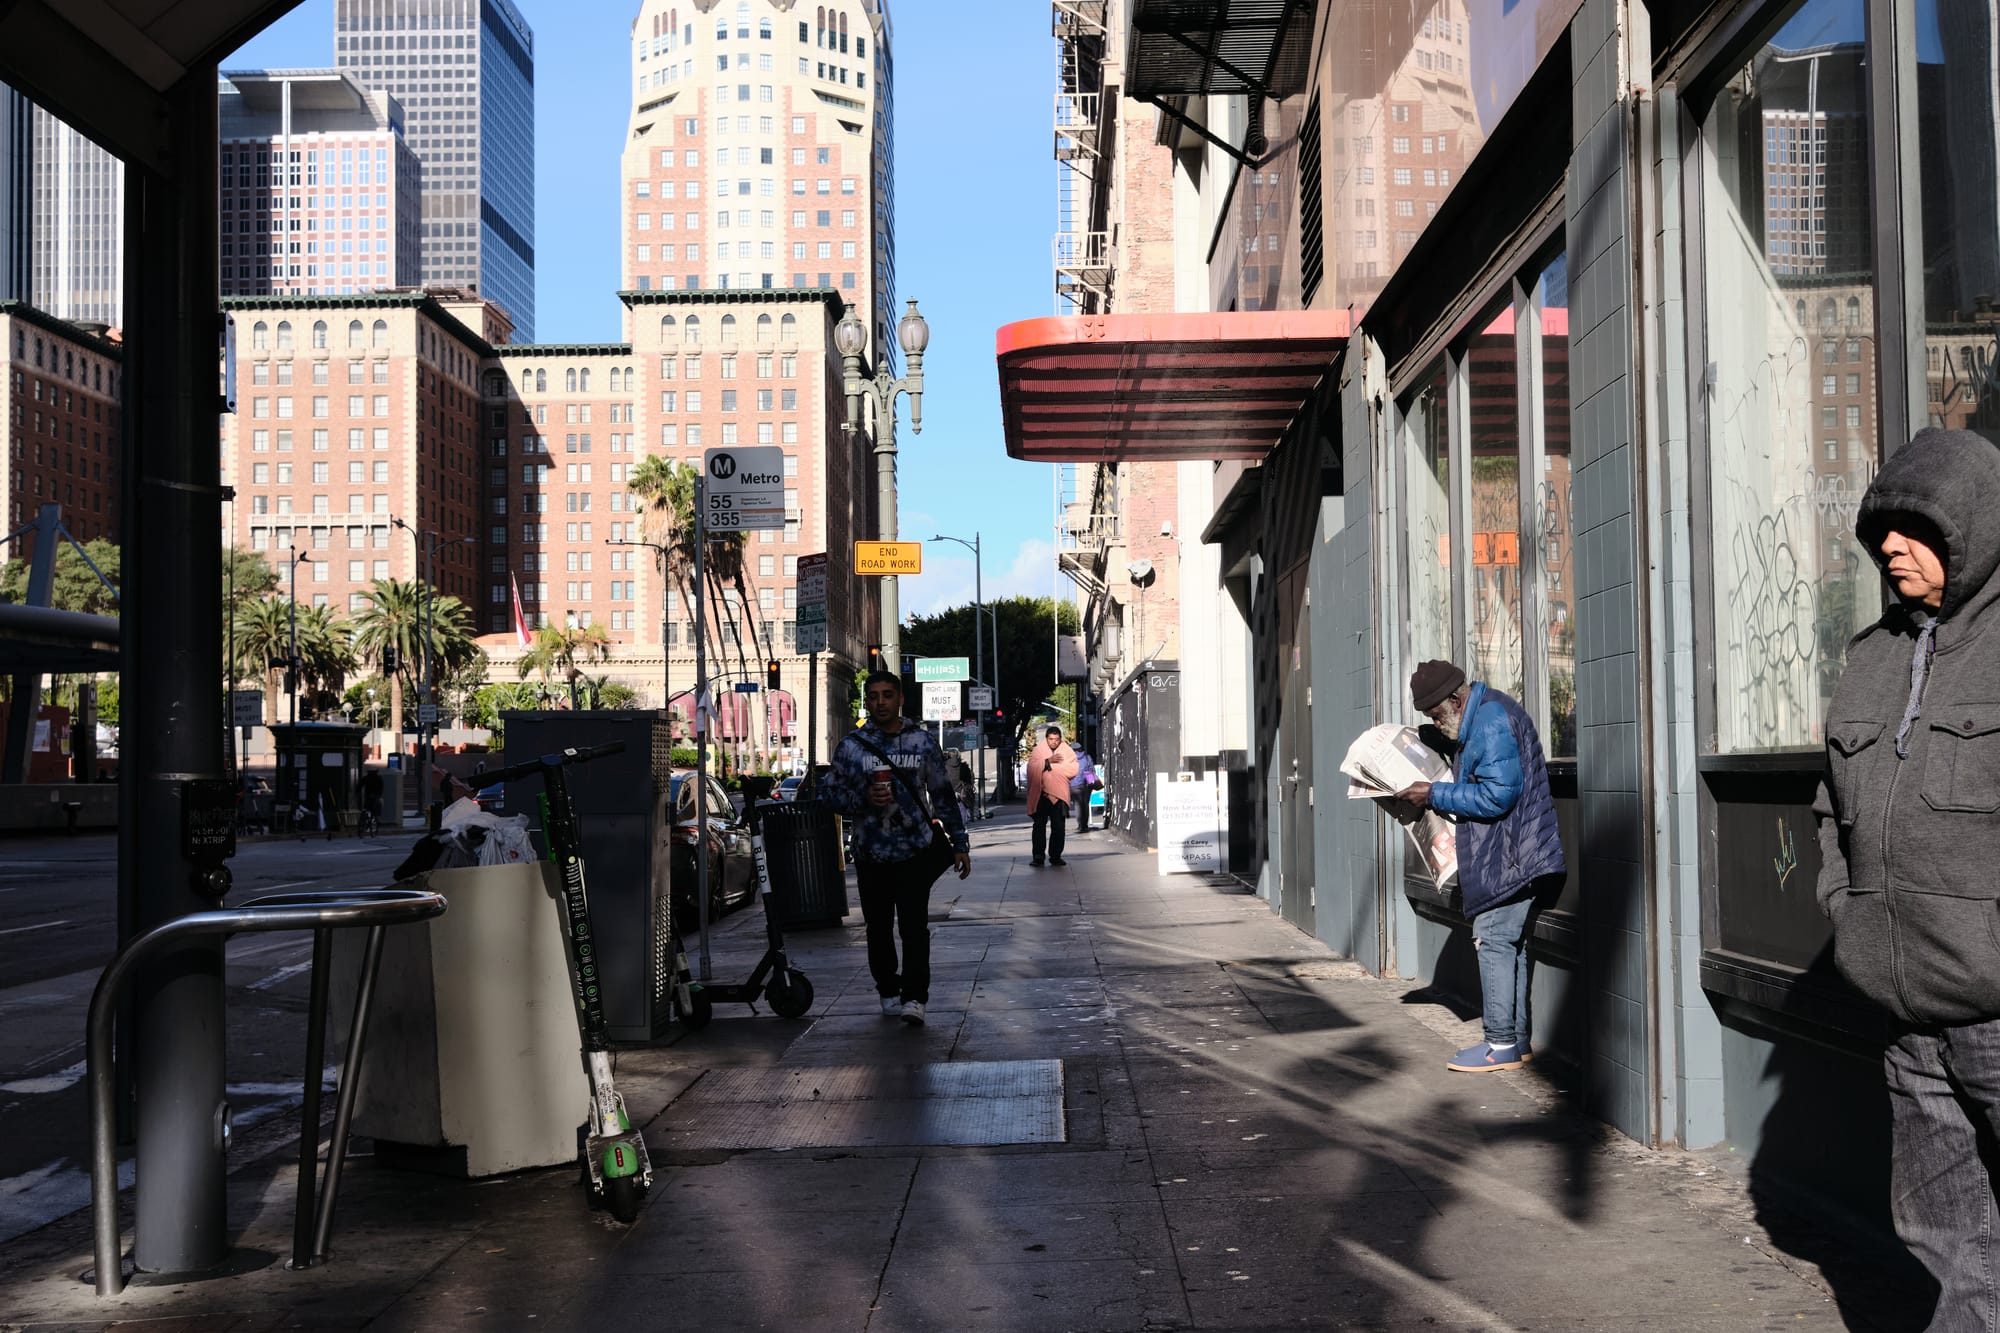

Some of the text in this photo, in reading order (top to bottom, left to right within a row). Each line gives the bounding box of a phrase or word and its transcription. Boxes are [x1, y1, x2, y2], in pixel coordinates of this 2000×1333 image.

[714, 458, 732, 475] M
[741, 473, 781, 485] Metro
[710, 495, 732, 509] 55
[711, 512, 740, 526] 355
[879, 547, 898, 557] END
[861, 559, 916, 569] ROAD WORK
[924, 664, 961, 675] Hill St
[931, 696, 951, 705] MUST
[1167, 853, 1212, 861] COMPASS
[754, 846, 767, 884] BIRD
